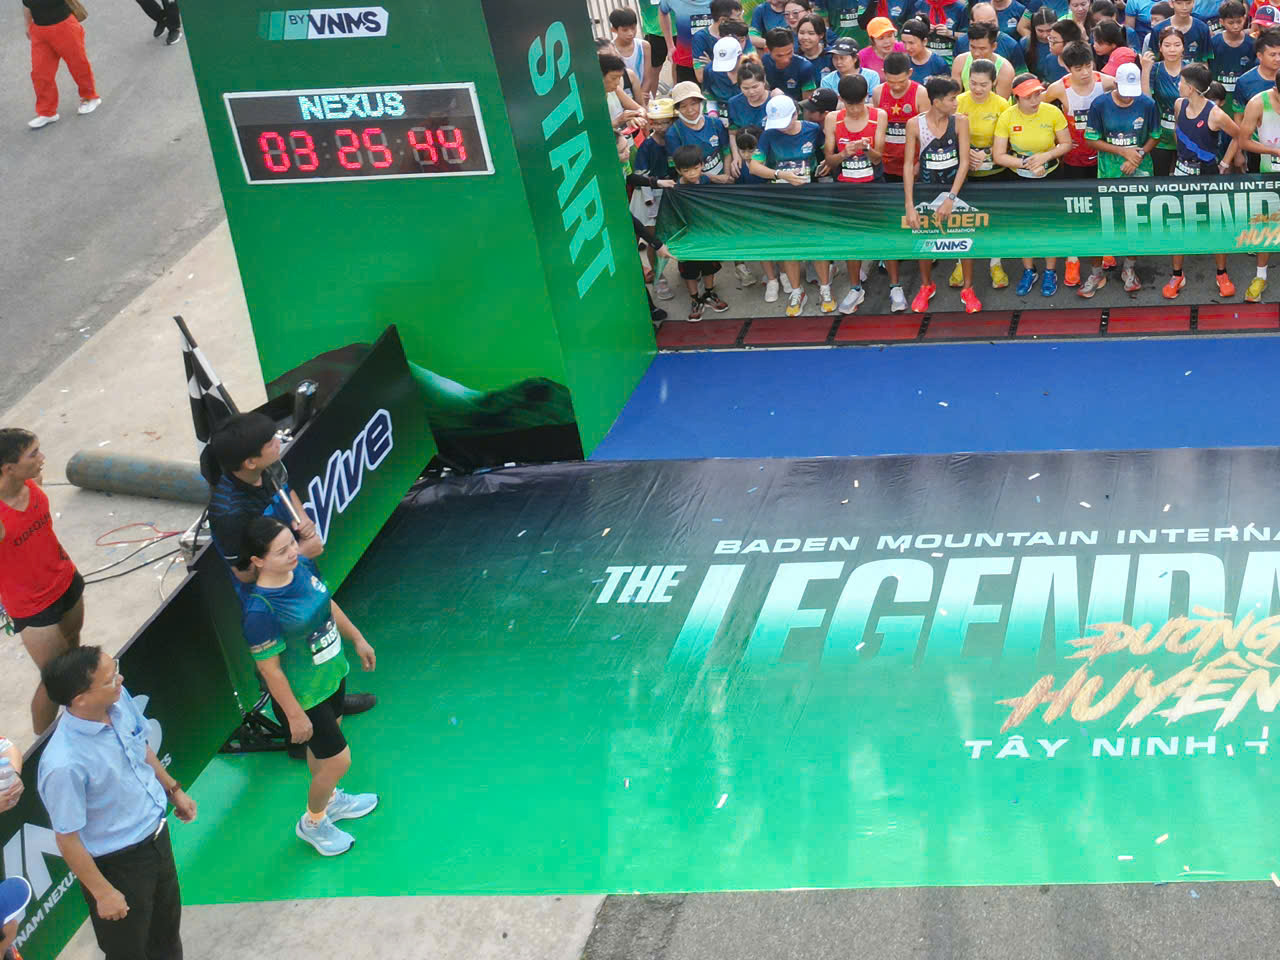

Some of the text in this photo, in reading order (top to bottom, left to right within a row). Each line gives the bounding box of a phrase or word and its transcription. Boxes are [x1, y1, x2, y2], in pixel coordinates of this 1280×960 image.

[289, 10, 381, 35] BY VNMS
[298, 92, 406, 120] NEXUS
[528, 21, 616, 300] START
[1098, 184, 1149, 193] BADEN
[1155, 182, 1234, 192] MOUNTAIN
[1064, 196, 1093, 213] THE
[947, 213, 989, 227] DEN
[934, 240, 968, 251] VNMS
[713, 535, 860, 554] BADEN
[877, 529, 1099, 550] MOUNTAIN
[596, 564, 687, 603] THE
[964, 735, 1069, 759] TÂY
[43, 871, 77, 914] NEXU
